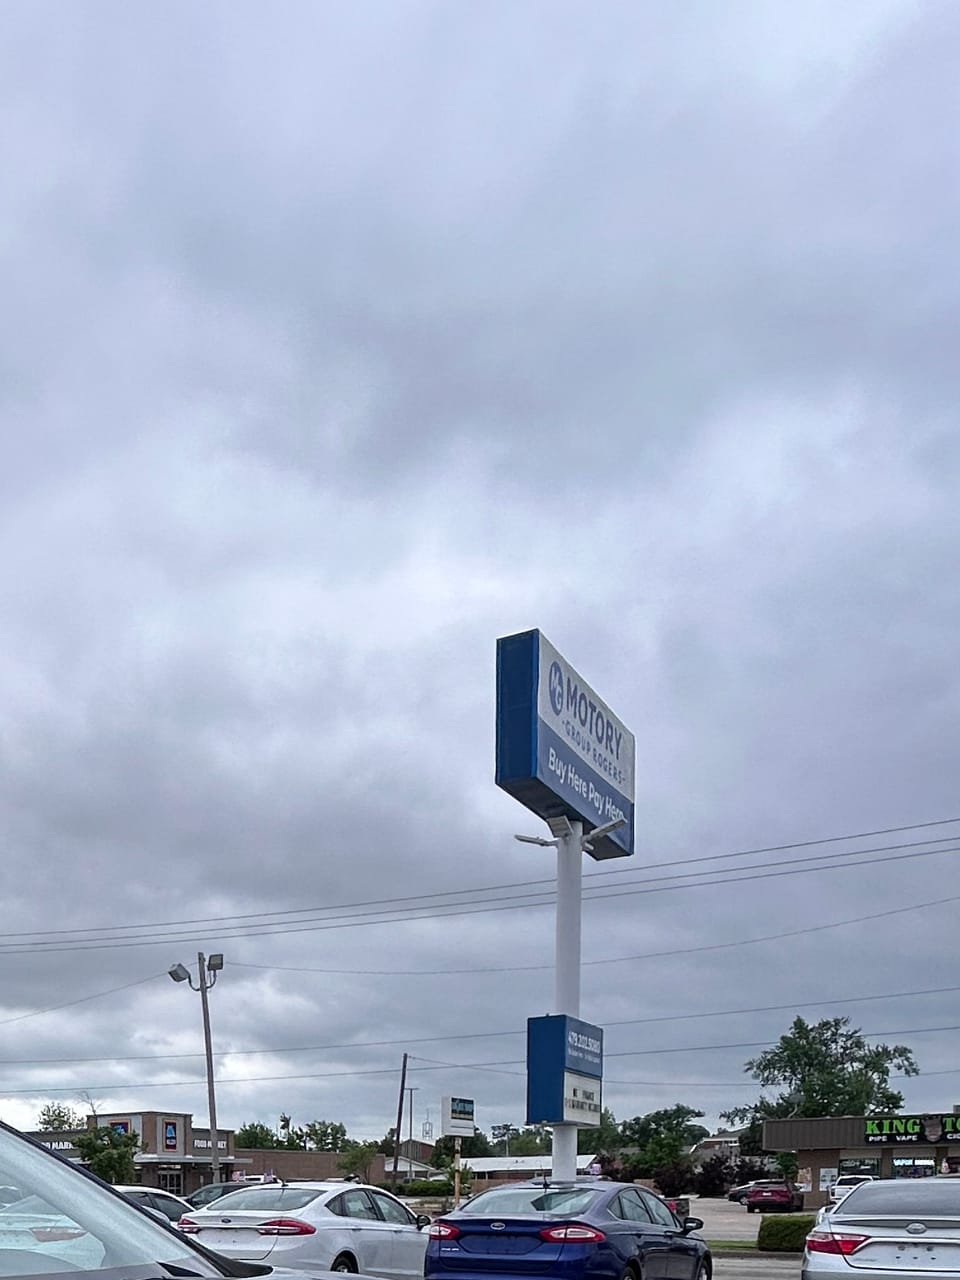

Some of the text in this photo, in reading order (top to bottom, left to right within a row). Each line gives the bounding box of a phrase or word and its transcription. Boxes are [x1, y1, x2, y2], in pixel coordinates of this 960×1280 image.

[566, 677, 623, 761] MOTORY
[548, 747, 567, 785] Buy
[568, 764, 587, 798] Here
[588, 782, 605, 815] Pay
[207, 1140, 228, 1149] MKET
[865, 1118, 921, 1134] KING
